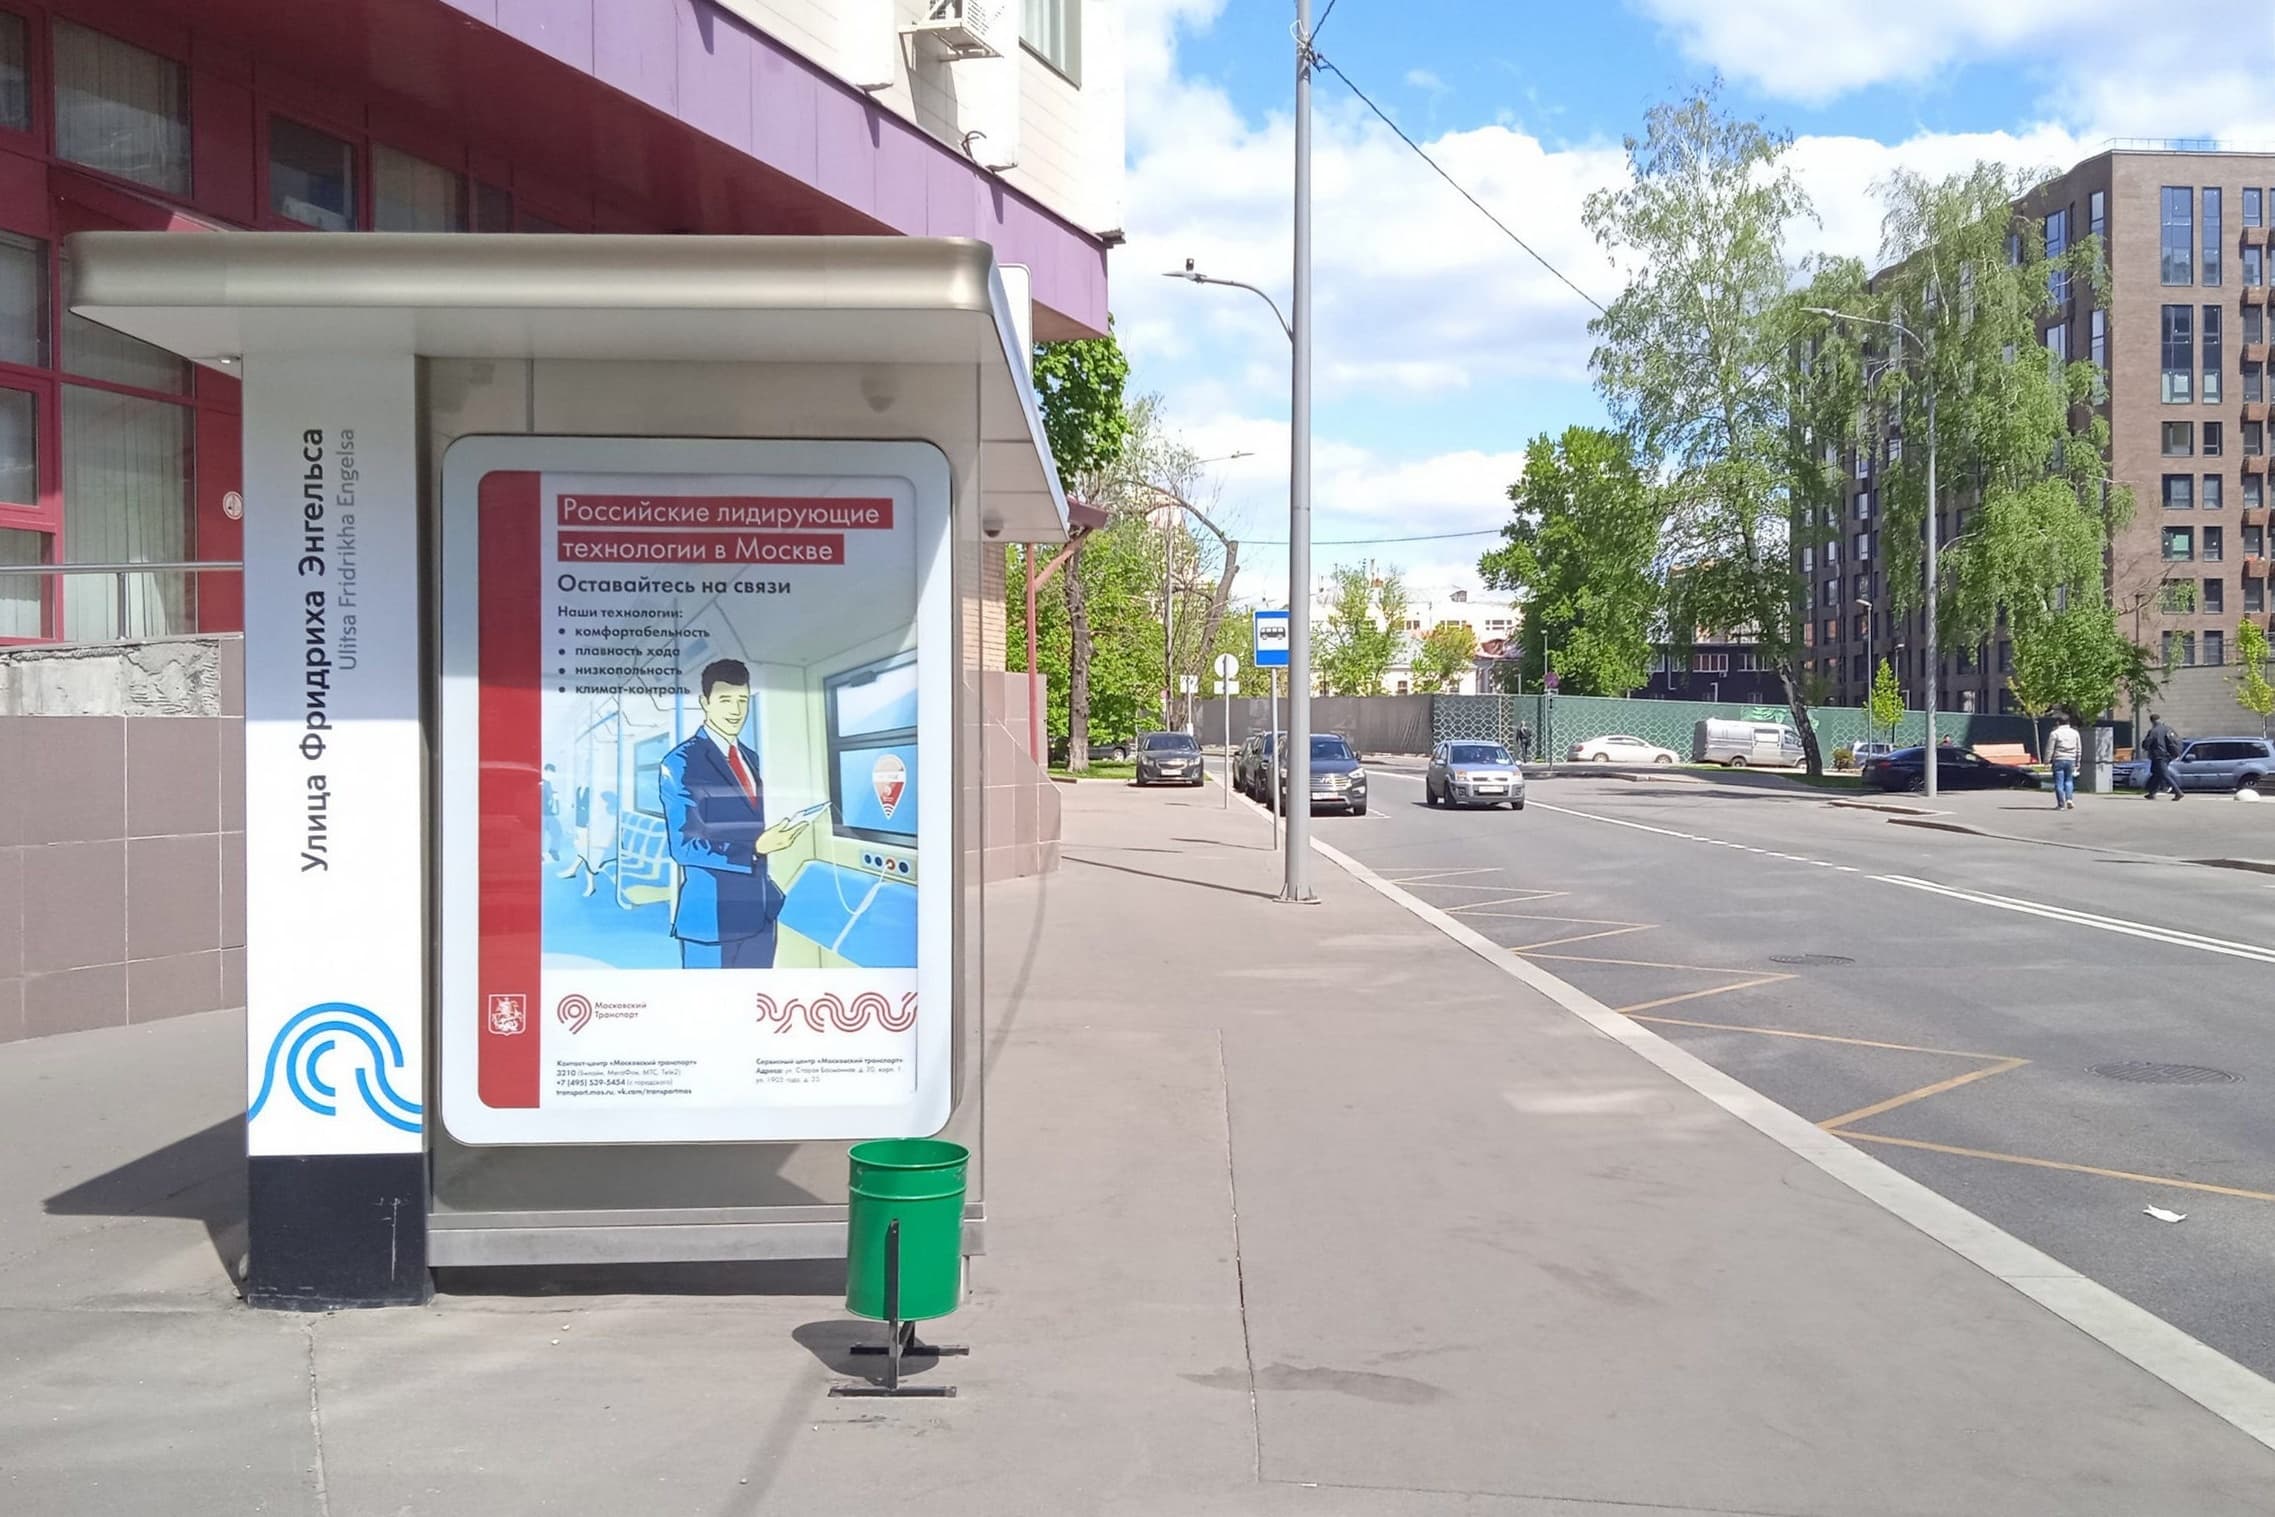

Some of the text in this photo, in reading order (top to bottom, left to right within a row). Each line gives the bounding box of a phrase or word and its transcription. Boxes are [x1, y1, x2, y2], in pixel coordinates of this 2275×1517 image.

[562, 498, 880, 529] Российские лидирующие
[337, 428, 360, 670] Ulitsa Fridrikha Engelsa
[562, 537, 833, 561] технологии в Москве
[558, 574, 791, 595] Оставайтесь на связи
[558, 606, 684, 620] Наши технологии:
[575, 625, 711, 641] комфортабельность
[298, 427, 332, 873] Улица Фридриха Энгельса
[575, 646, 681, 659] плавность хода
[575, 665, 683, 677] низкопольность
[575, 684, 691, 697] климат-контроль
[595, 1001, 647, 1009] Московский
[595, 1011, 639, 1020] Транспорт
